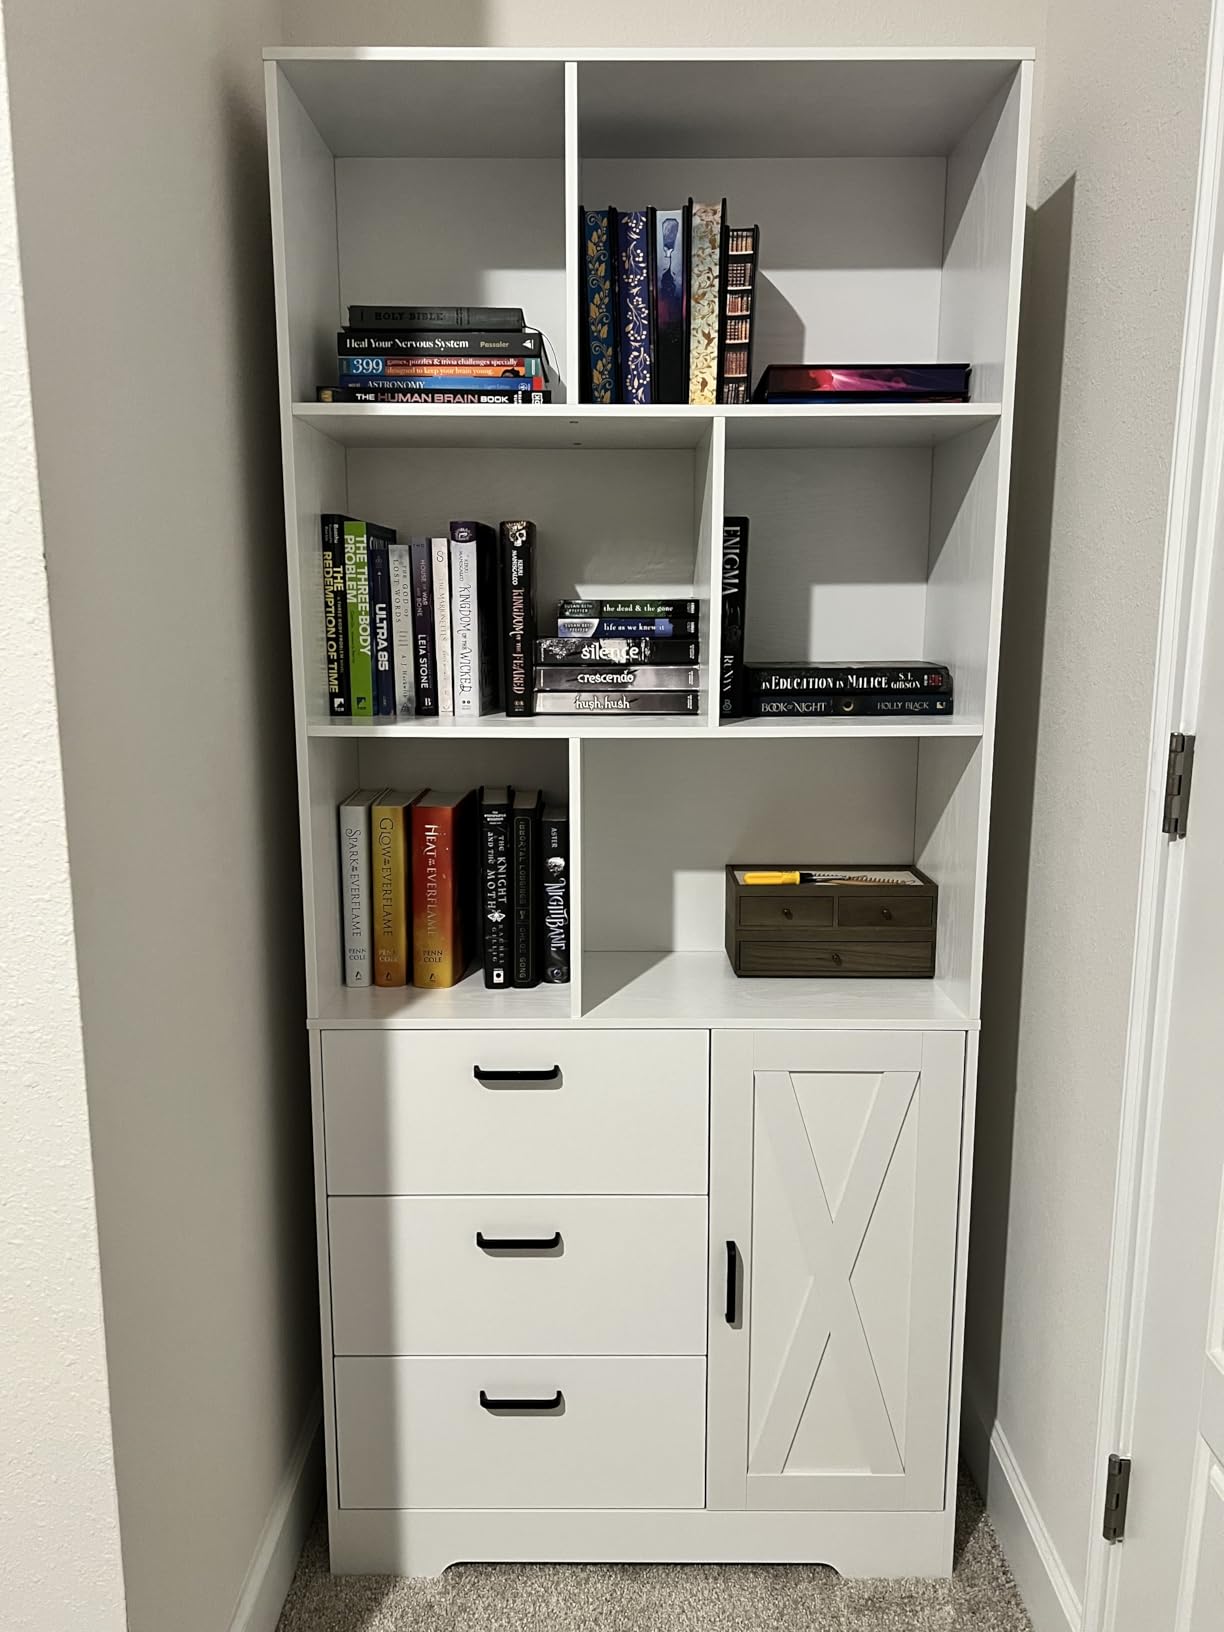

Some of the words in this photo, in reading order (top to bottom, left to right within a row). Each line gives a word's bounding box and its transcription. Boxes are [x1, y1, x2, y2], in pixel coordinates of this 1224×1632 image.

[374, 311, 405, 321] HOLY
[408, 311, 445, 321] BIBLE
[346, 338, 368, 348] Heal
[369, 338, 393, 348] Your
[394, 338, 434, 348] Nervous
[435, 338, 469, 351] System
[352, 358, 383, 374] 399
[458, 358, 490, 367] challenges
[355, 393, 375, 401] THE
[378, 393, 432, 403] HUMAN
[434, 393, 478, 404] BRAIN
[480, 395, 509, 403] BOOK
[367, 380, 425, 389] ASTRONOMY
[355, 534, 368, 562] THE
[722, 526, 741, 596] ENIGMA
[333, 564, 345, 592] THE
[344, 535, 362, 603] PROBLEM
[323, 551, 337, 638] REDEMPTION
[457, 584, 472, 635] KINGDOM
[357, 566, 371, 656] THREE-BODY
[376, 603, 388, 650] ULTRA
[509, 588, 525, 637] KINGDOM
[327, 640, 337, 660] OF
[418, 634, 427, 656] LEIA
[581, 642, 639, 660] silence
[378, 651, 389, 671] 85
[420, 657, 429, 689] STONE
[459, 647, 473, 696] WICKED
[512, 653, 526, 694] FEARED
[577, 670, 634, 683] crescendo
[328, 662, 339, 693] TIME
[771, 675, 834, 690] EDUCATION
[847, 674, 888, 689] MALICE
[890, 681, 920, 689] GIBSON
[576, 695, 604, 710] hush,
[605, 694, 630, 709] hush
[761, 702, 788, 712] BOOK
[792, 701, 827, 713] NIGHT
[877, 702, 903, 710] HOLLY
[905, 701, 929, 711] BLACK
[345, 828, 362, 865] SPARK
[379, 817, 394, 858] GLOW
[423, 824, 440, 858] HEAT
[518, 820, 527, 863] IMMORTAL
[487, 849, 495, 865] THE
[487, 869, 497, 909] MOTH
[497, 856, 508, 904] KNIGHT
[350, 874, 362, 937] EVERFLAME
[381, 867, 394, 937] EVERFLAME
[426, 867, 438, 937] EVERFLAME
[544, 877, 568, 951] NIGHTBANE
[519, 957, 527, 978] GONG
